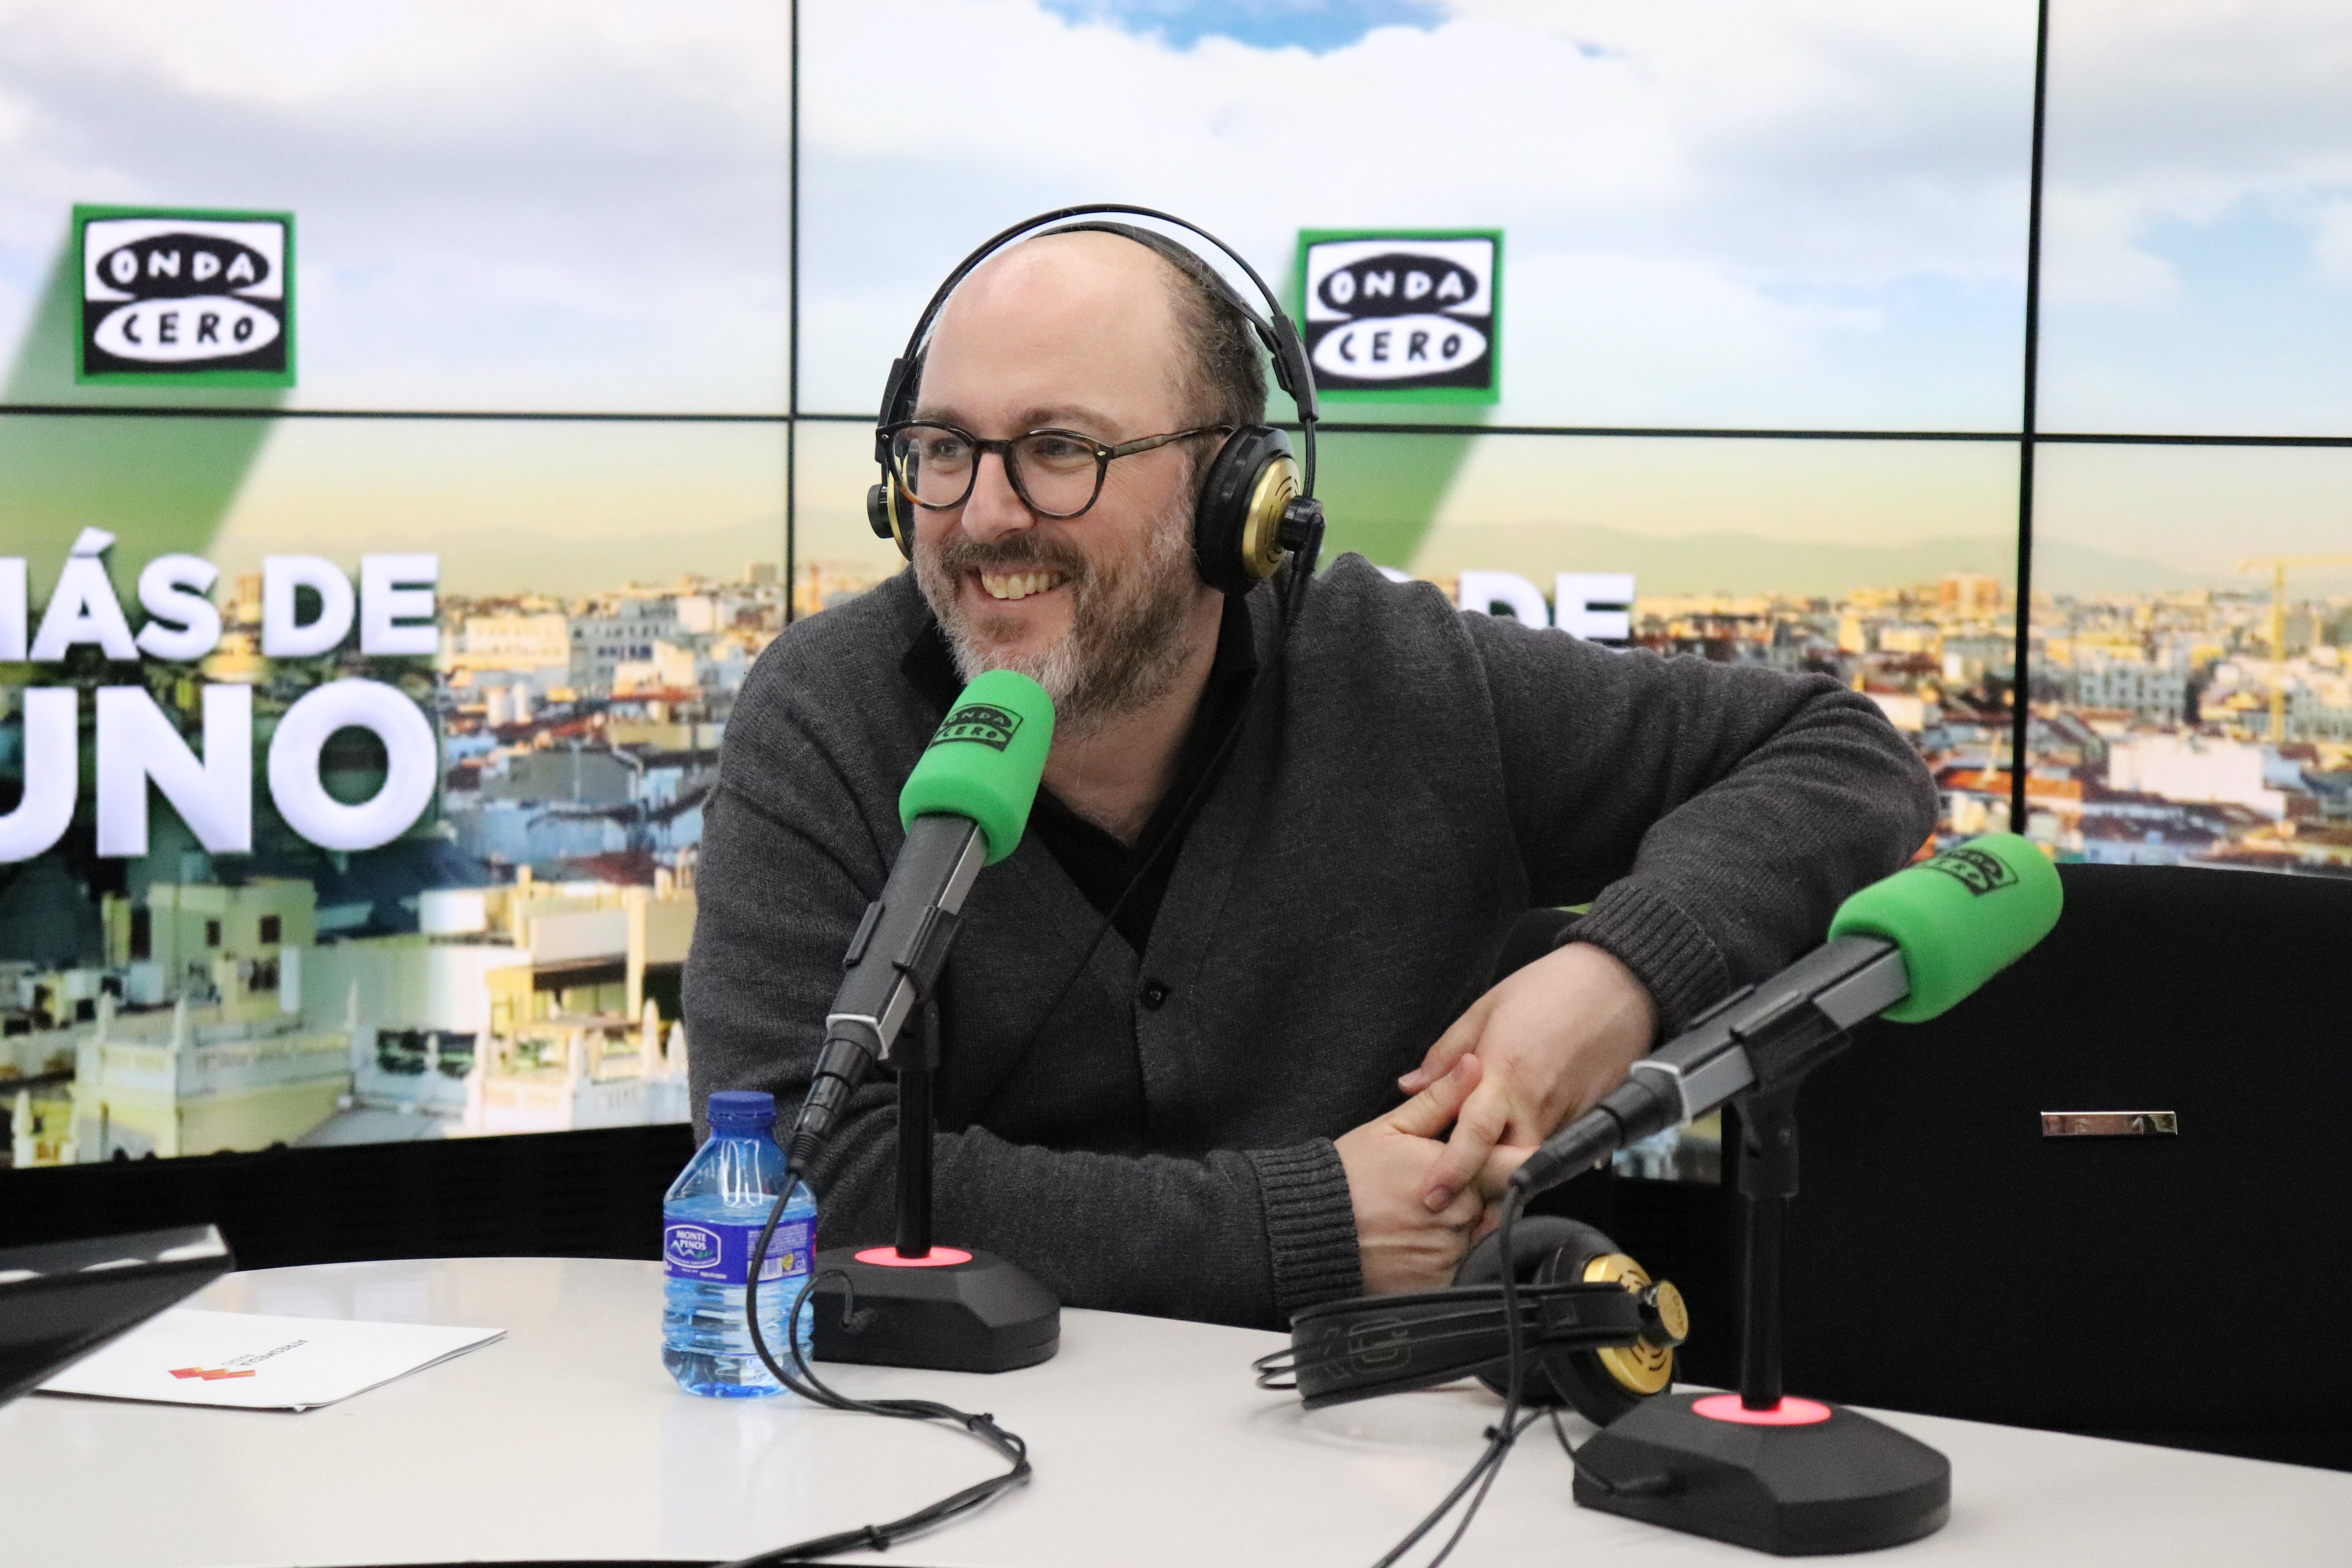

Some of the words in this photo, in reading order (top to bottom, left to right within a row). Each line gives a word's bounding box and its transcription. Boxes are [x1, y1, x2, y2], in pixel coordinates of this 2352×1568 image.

[110, 249, 255, 285] ONDA
[1330, 269, 1465, 305] ONDA
[122, 312, 254, 345] CERO
[1339, 330, 1461, 363] CERO
[0, 526, 222, 662] ÁS
[262, 553, 439, 657] DE
[948, 712, 1004, 725] ONDA
[676, 1230, 706, 1242] MONTE
[680, 1239, 706, 1251] PINOS
